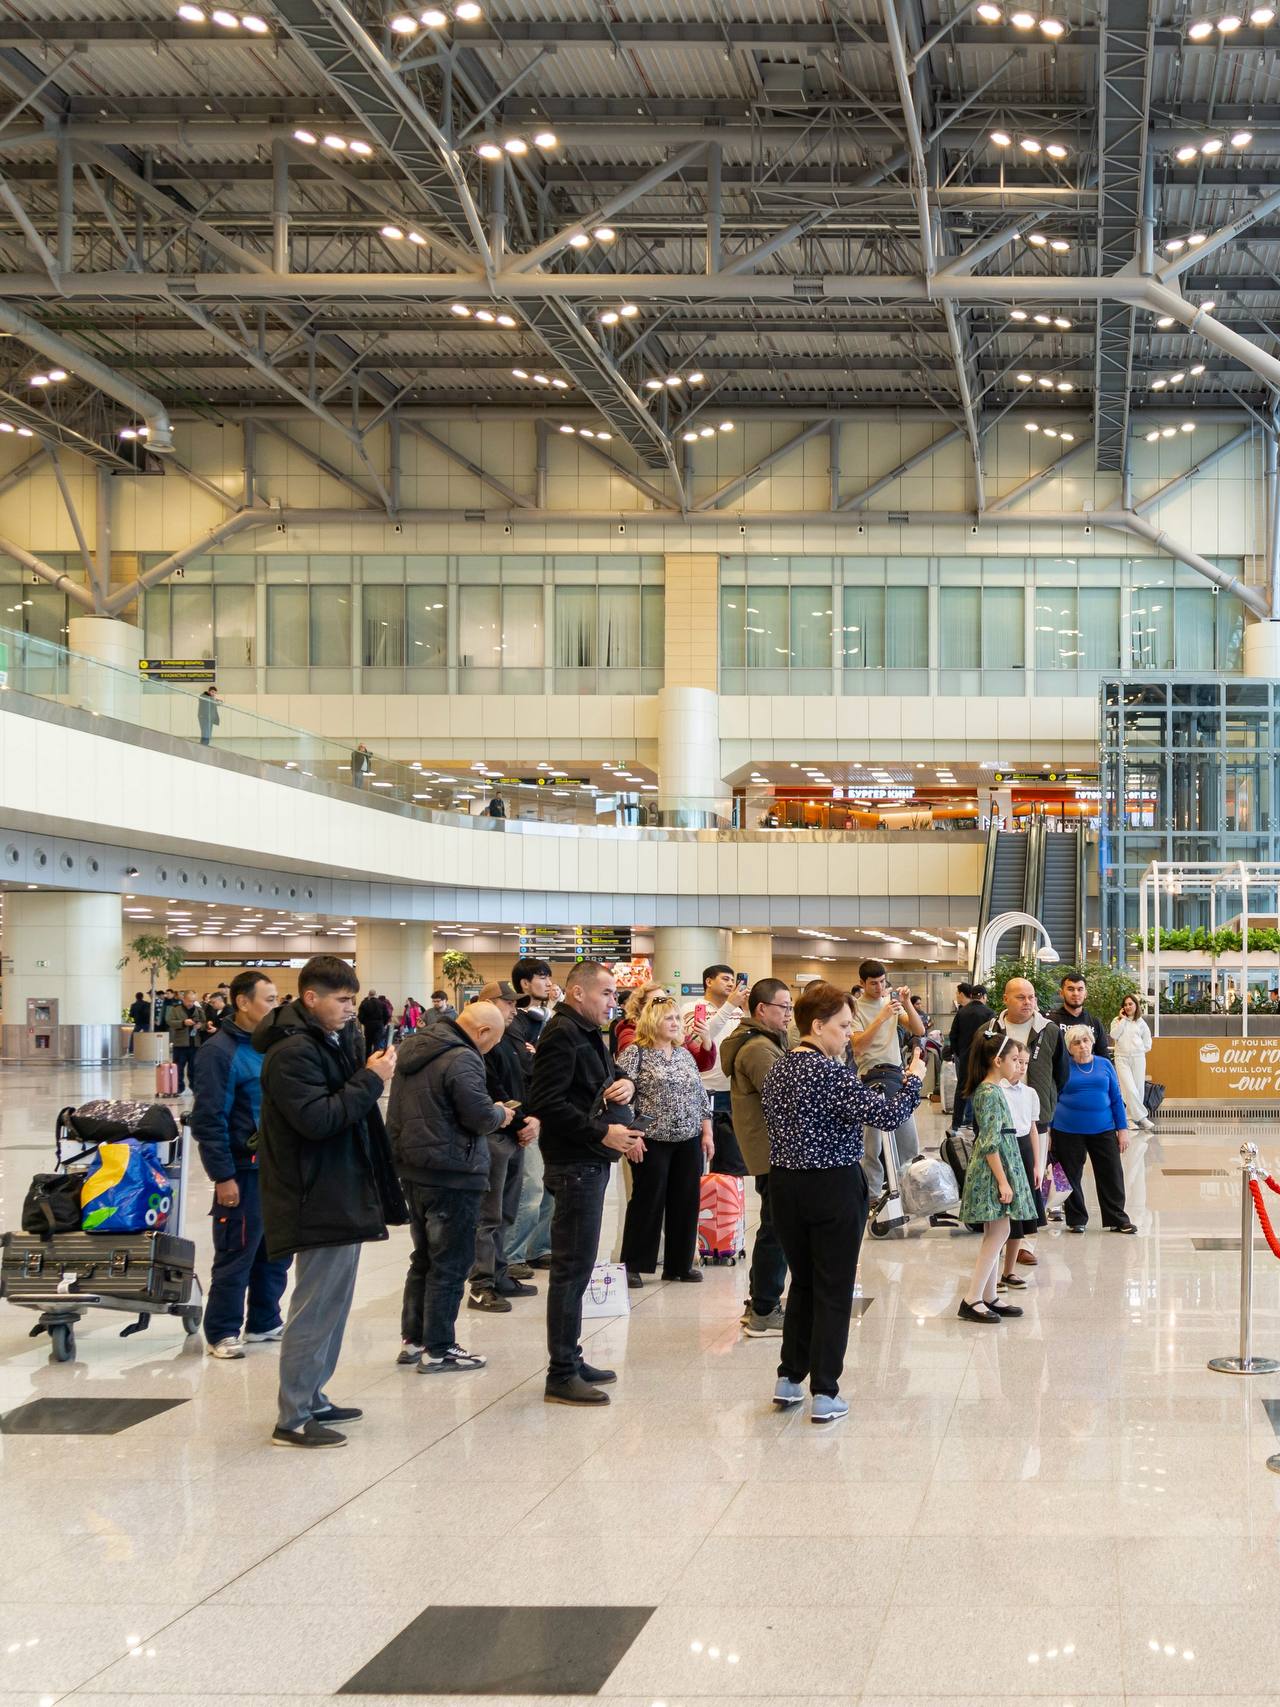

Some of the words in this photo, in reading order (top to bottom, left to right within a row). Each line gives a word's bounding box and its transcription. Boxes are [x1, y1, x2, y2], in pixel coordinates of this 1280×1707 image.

[1231, 1039, 1240, 1047] IF
[1241, 1039, 1258, 1047] YOU
[1260, 1039, 1278, 1047] LIKE
[1222, 1047, 1256, 1064] our
[1210, 1066, 1228, 1074] YOU
[1229, 1066, 1249, 1074] WILL
[1251, 1066, 1273, 1074] LOVE
[1229, 1074, 1272, 1091] our
